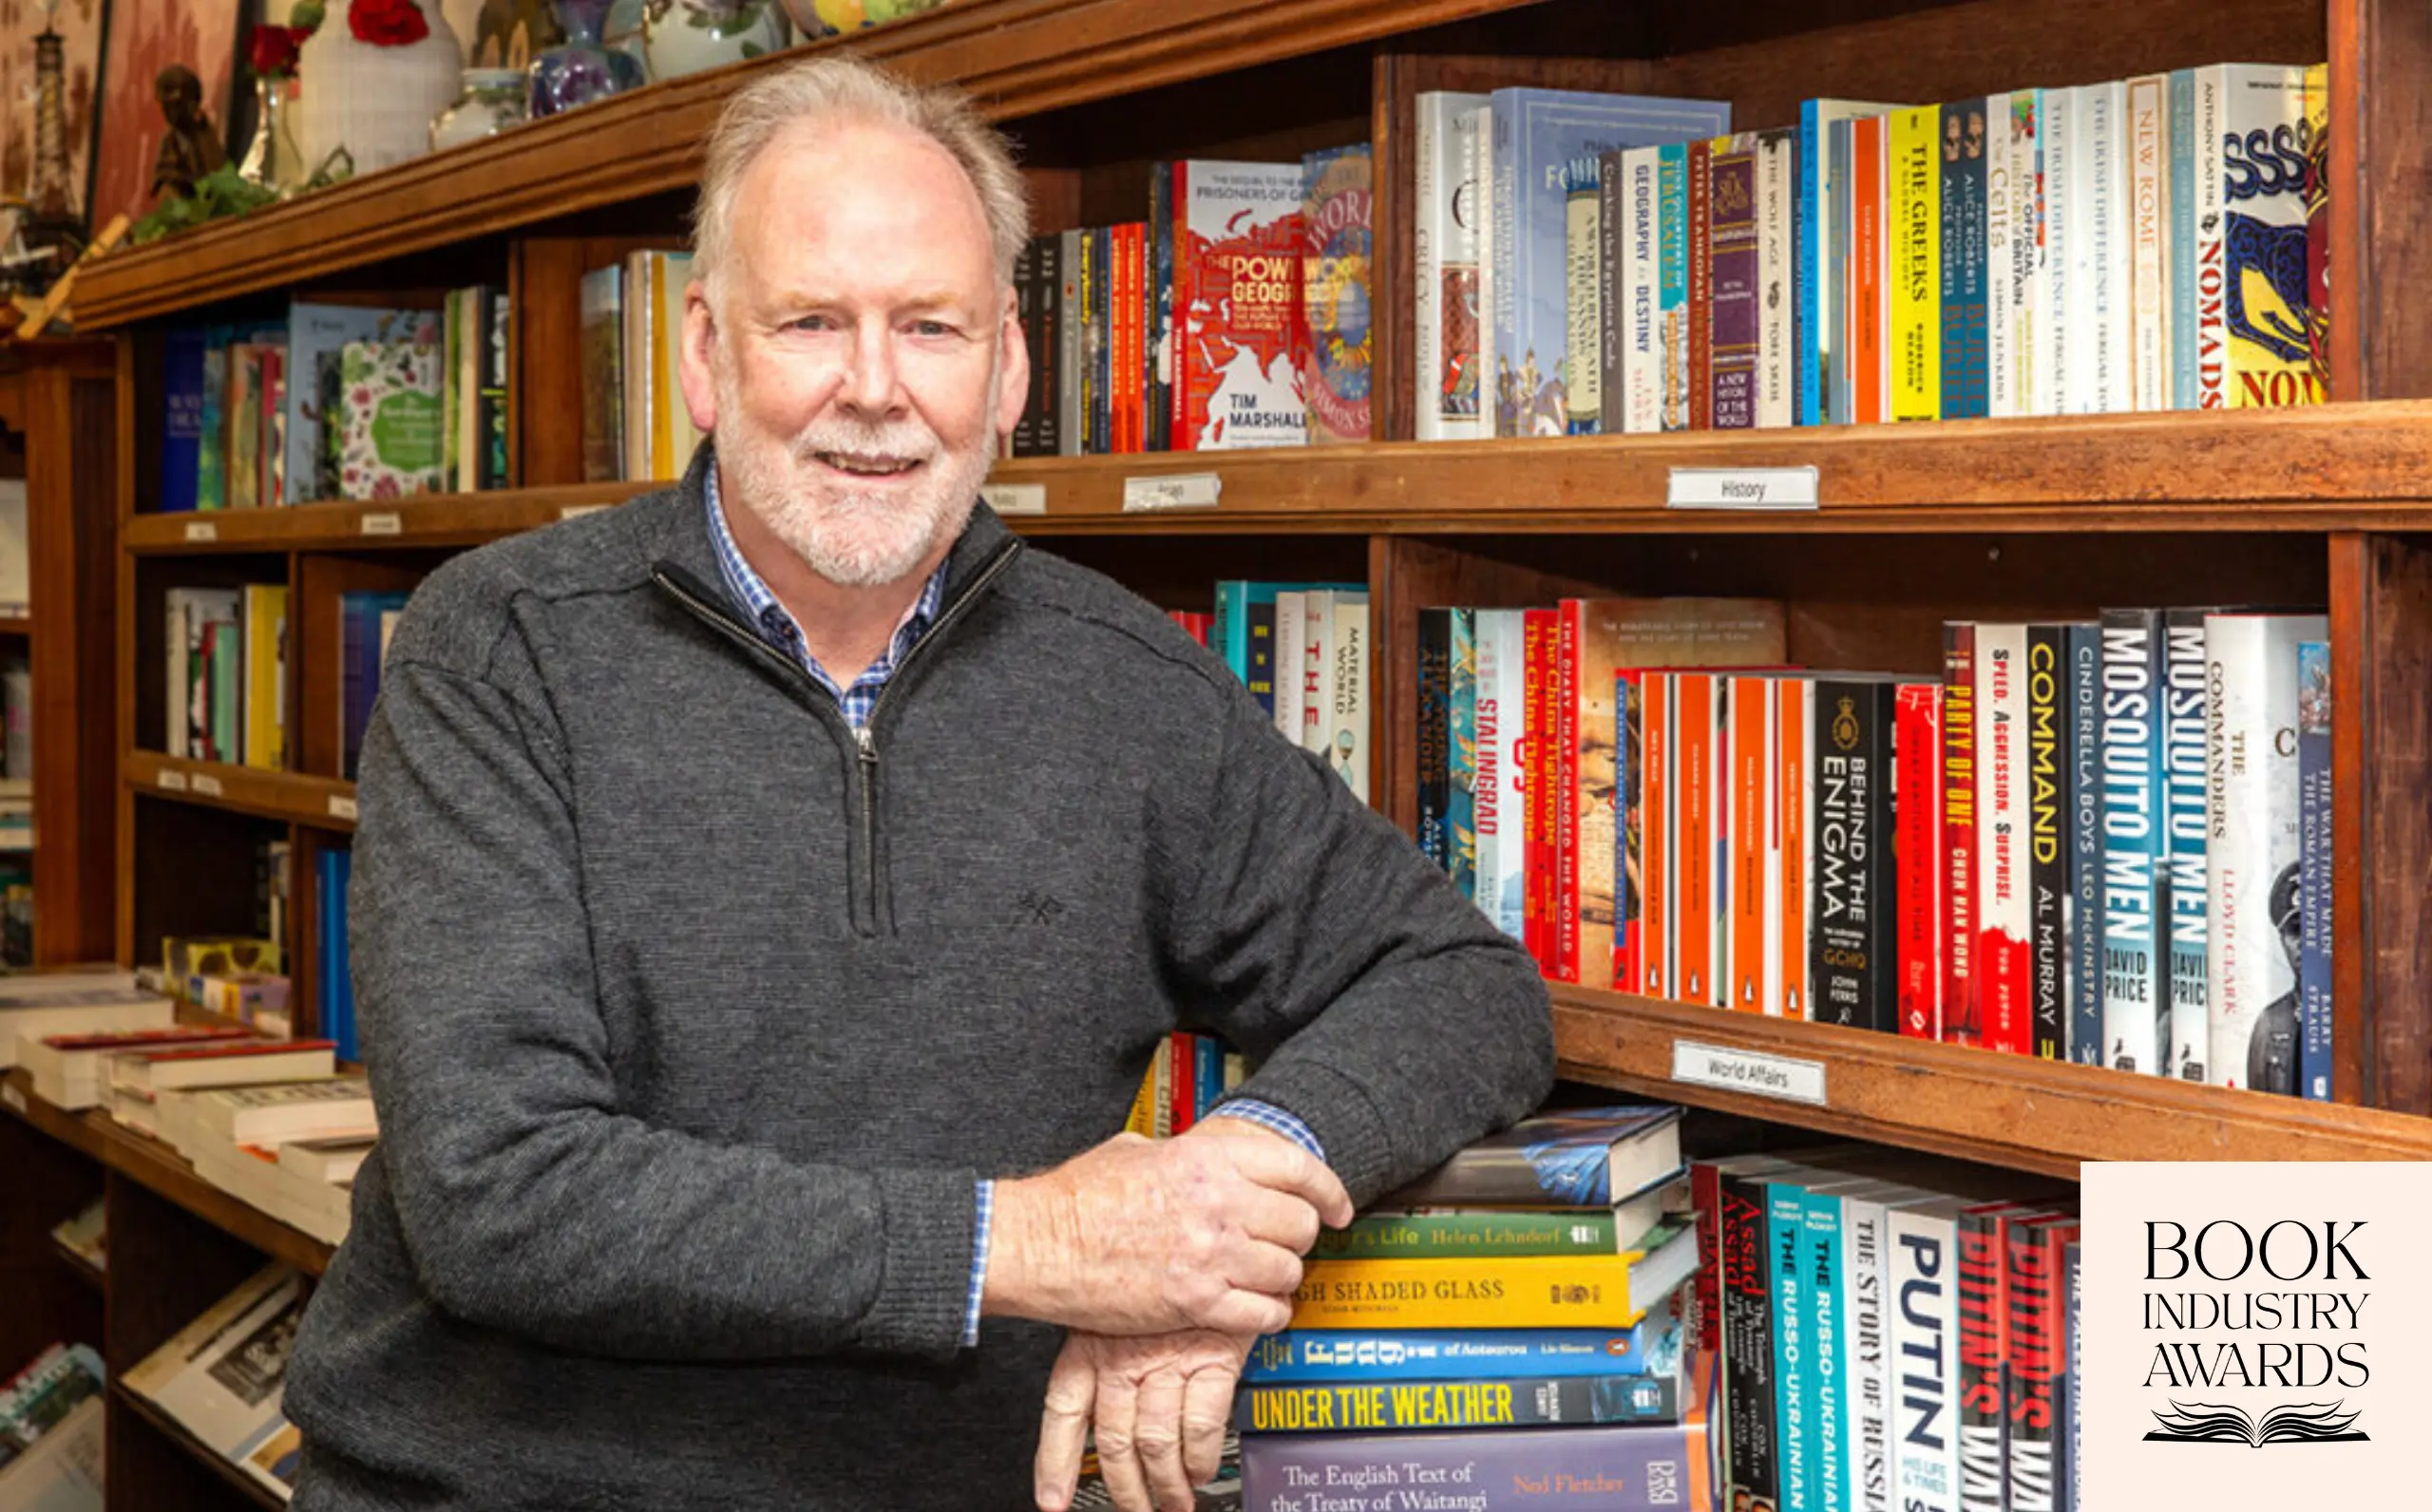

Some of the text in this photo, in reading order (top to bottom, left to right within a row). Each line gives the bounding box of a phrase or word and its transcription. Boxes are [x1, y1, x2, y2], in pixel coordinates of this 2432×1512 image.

[1197, 186, 1264, 200] PRISONERS
[1768, 159, 1778, 183] THE
[1911, 142, 1928, 196] THE
[2138, 109, 2155, 245] NEW ROME
[2203, 83, 2215, 207] ANTHONY SATTIN
[1911, 200, 1928, 302] GREEKS
[1943, 177, 1955, 297] ALICE ROBERTS
[1964, 175, 1976, 295] ALICE ROBERTS
[1989, 167, 2008, 249] Celts
[2023, 203, 2035, 279] OFFICIAL
[1635, 164, 1649, 353] GEOGRAPHY DESTINY
[2012, 237, 2024, 307] BRITAIN
[1944, 306, 1963, 419] BURIED
[1966, 304, 1985, 419] BURIED
[2199, 239, 2222, 410] NOMADS
[1229, 393, 1258, 409] TIM
[1721, 481, 1766, 501] History
[1304, 640, 1320, 728] THE
[1336, 647, 1347, 715] WORLD
[1347, 627, 1359, 716] MATERIAL
[1475, 698, 1498, 837] STALINGRAD
[1525, 621, 1540, 842] The China Tightrope
[1545, 625, 1559, 846] The China Tightrope
[1945, 685, 1973, 827] PARTY OF ONE
[2029, 642, 2057, 865] COMMAND
[2079, 647, 2094, 854] CINDERELLA BOYS
[2211, 661, 2228, 840] COMMANDERS
[2232, 730, 2247, 777] THE
[1563, 622, 1573, 954] THE DIARY THAT CHANGED THE WORLD
[2102, 628, 2150, 942] MOSQUITO MEN
[2318, 768, 2331, 803] THE
[2319, 808, 2331, 851] WAR
[1823, 756, 1847, 918] ENIGMA
[1849, 756, 1867, 922] BEHIND THE
[2304, 772, 2318, 949] THE ROMAN EMPIRE
[2319, 855, 2331, 904] THAT
[2081, 862, 2095, 1017] LEO McKINSTRY
[2172, 852, 2207, 945] MEN
[2222, 869, 2238, 1016] LLOYD CLARK
[2037, 885, 2056, 1027] AL MURRAY
[2105, 947, 2148, 974] DAVID
[2105, 977, 2148, 1005] PRICE
[1708, 1059, 1789, 1088] World Affairs
[1380, 1226, 1418, 1245] Life
[1432, 1226, 1560, 1245] Helen Lehndorf
[1721, 1189, 1743, 1288] Assad
[1739, 1197, 1766, 1296] Assad
[1814, 1238, 1831, 1287] THE
[1335, 1278, 1505, 1302] SHADED GLASS
[1856, 1219, 1882, 1408] THE STORY OF
[1445, 1343, 1459, 1356] of
[1460, 1343, 1527, 1357] Aotearoa
[1780, 1228, 1805, 1509] THE RUSSO-UKRAINIAN
[1899, 1233, 1945, 1451] PUTIN
[1252, 1386, 1334, 1429] UNDER
[1336, 1385, 1388, 1427] THE
[1391, 1383, 1514, 1425] WEATHER
[1271, 1490, 1488, 1512] the Treaty of Waitangi
[1282, 1461, 1473, 1493] The English Text of
[1513, 1473, 1624, 1495] Ned Fletcher
